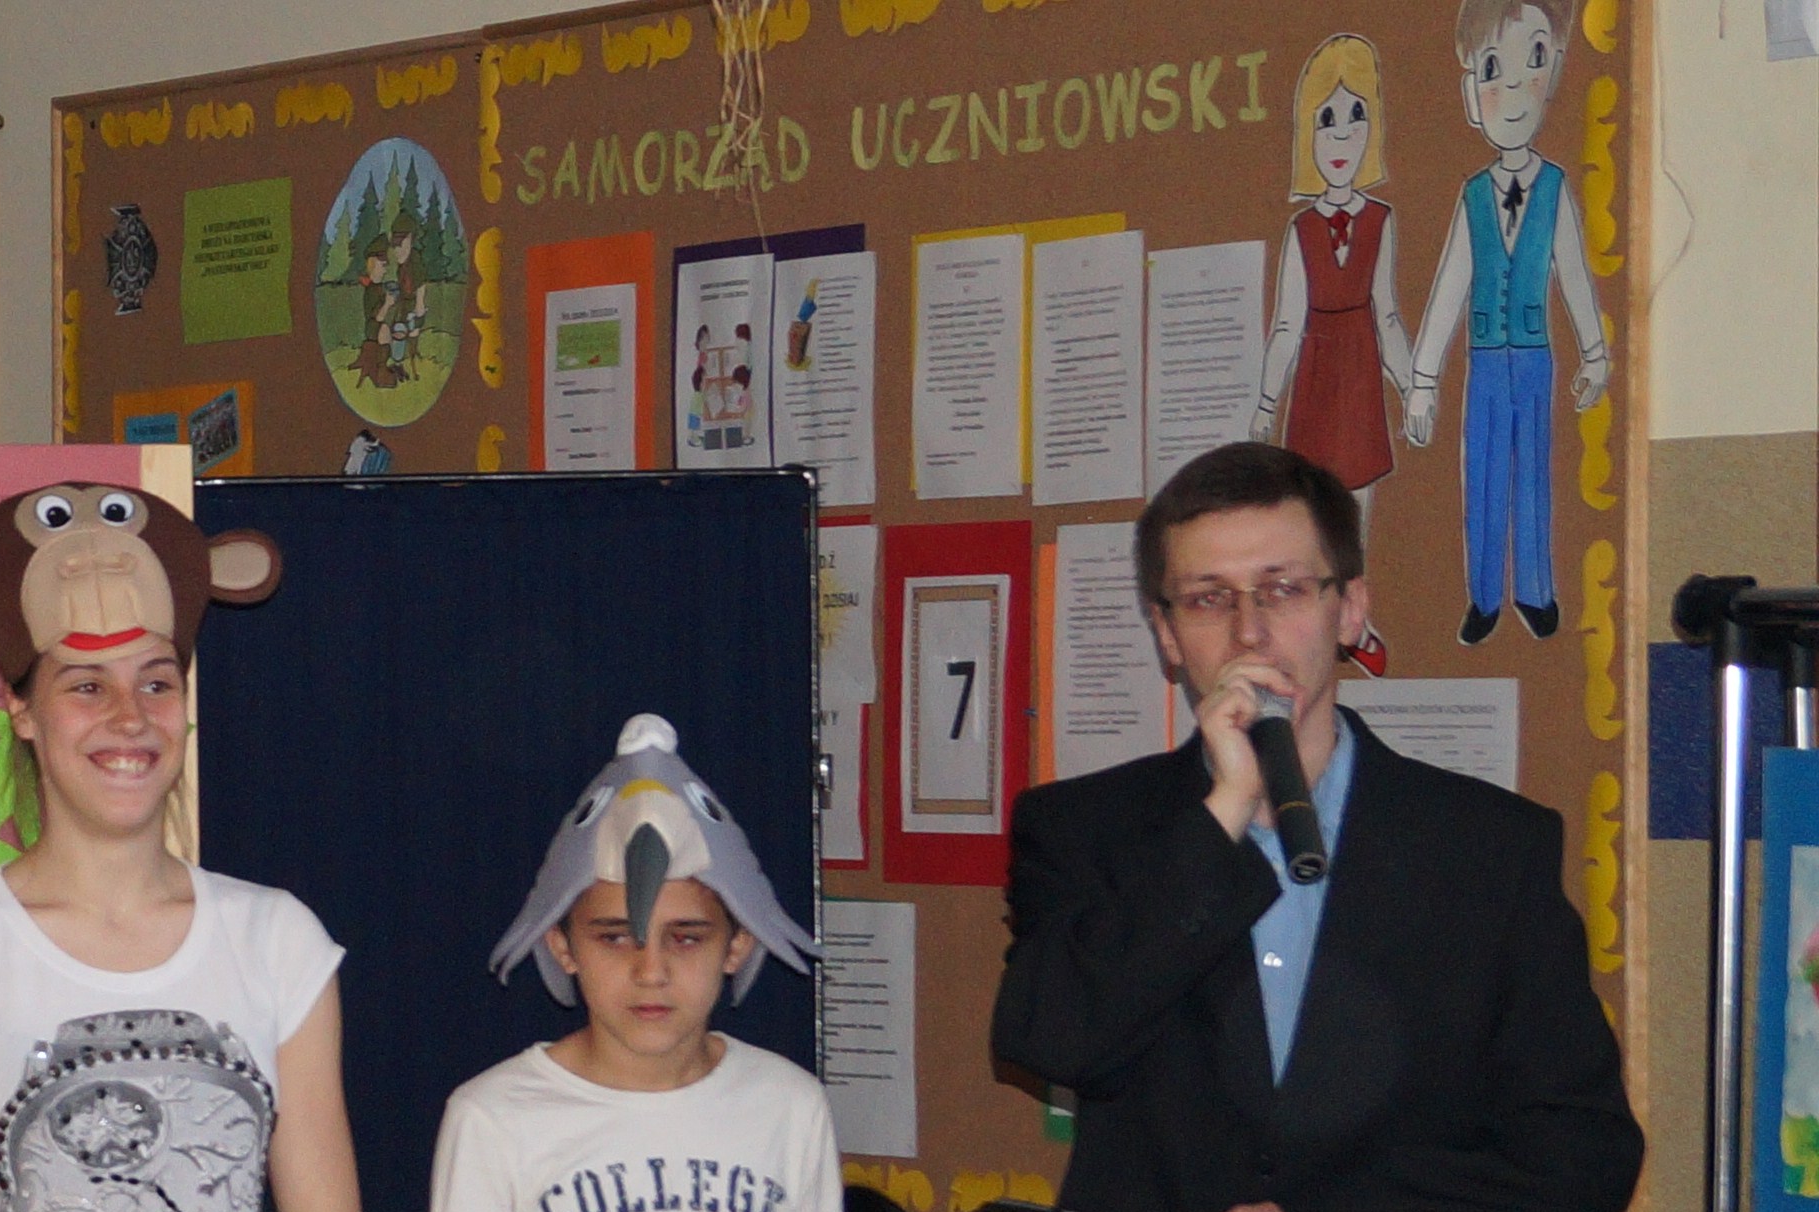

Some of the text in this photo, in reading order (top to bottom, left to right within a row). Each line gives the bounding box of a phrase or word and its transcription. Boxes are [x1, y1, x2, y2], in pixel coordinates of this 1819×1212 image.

[515, 50, 1268, 206] SAMORZĄD UCZNIOWSKI
[947, 661, 976, 740] 7
